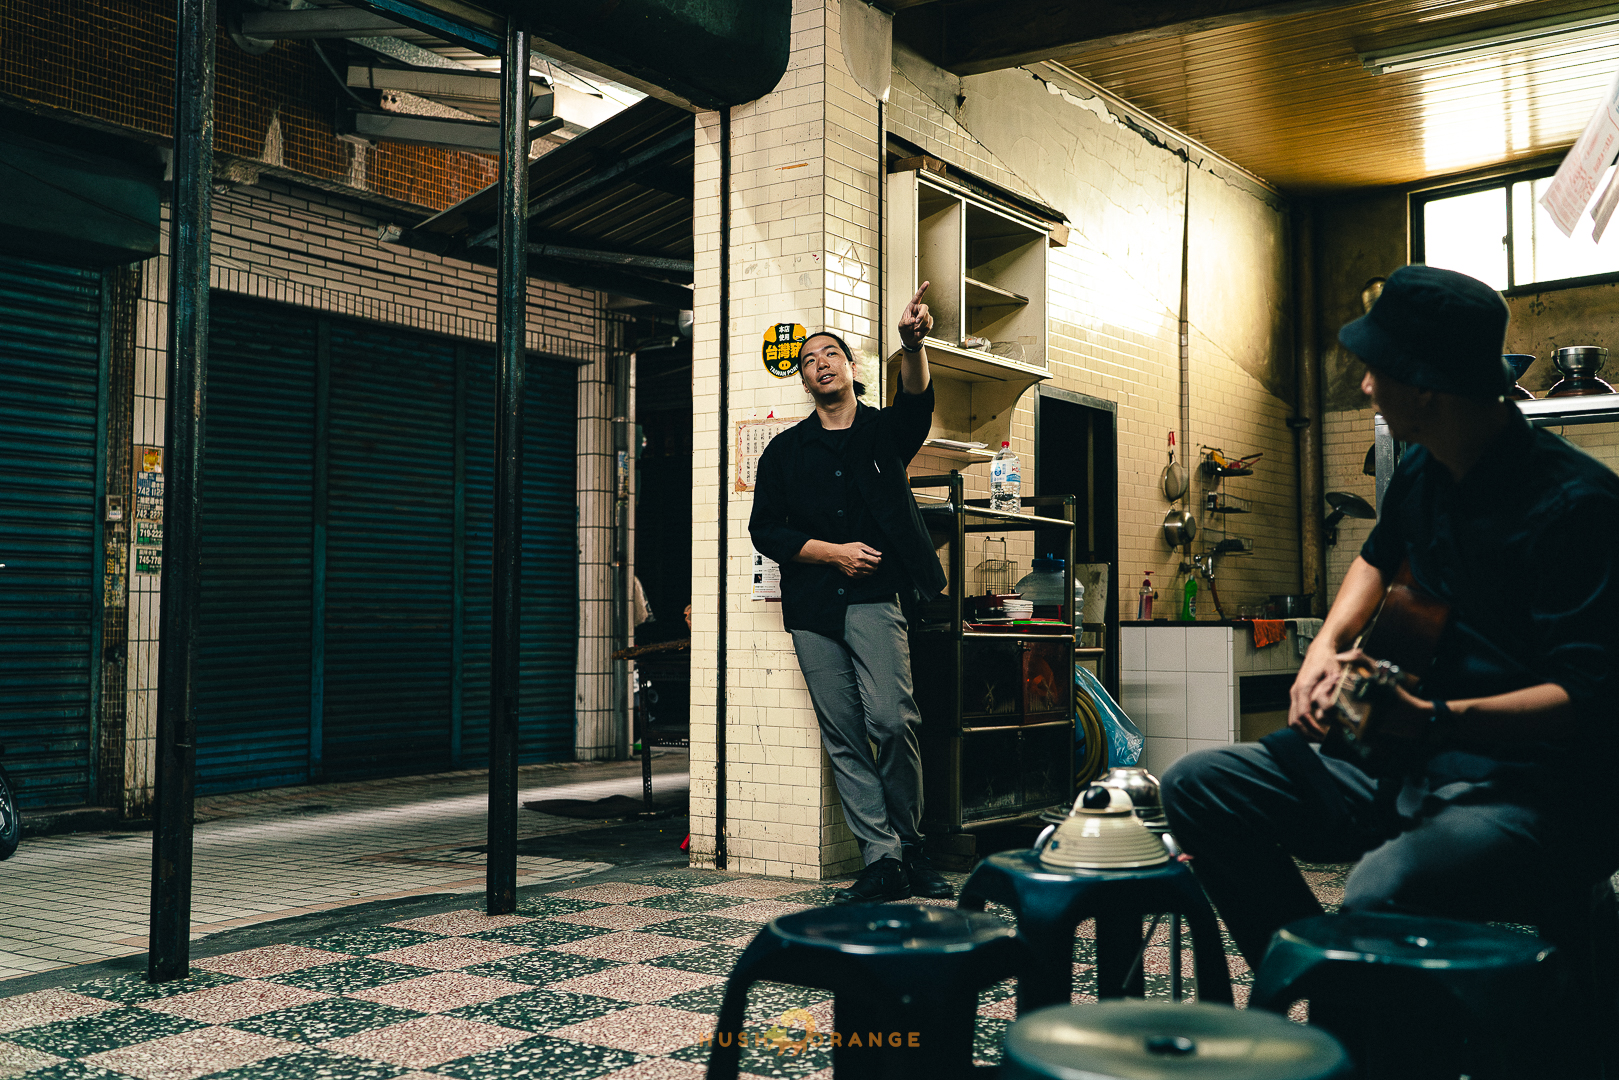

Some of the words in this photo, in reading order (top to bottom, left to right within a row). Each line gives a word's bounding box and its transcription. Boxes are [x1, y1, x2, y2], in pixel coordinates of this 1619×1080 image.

[778, 325, 790, 333] 本店
[778, 333, 790, 341] 使用
[769, 365, 787, 377] TAIWAN
